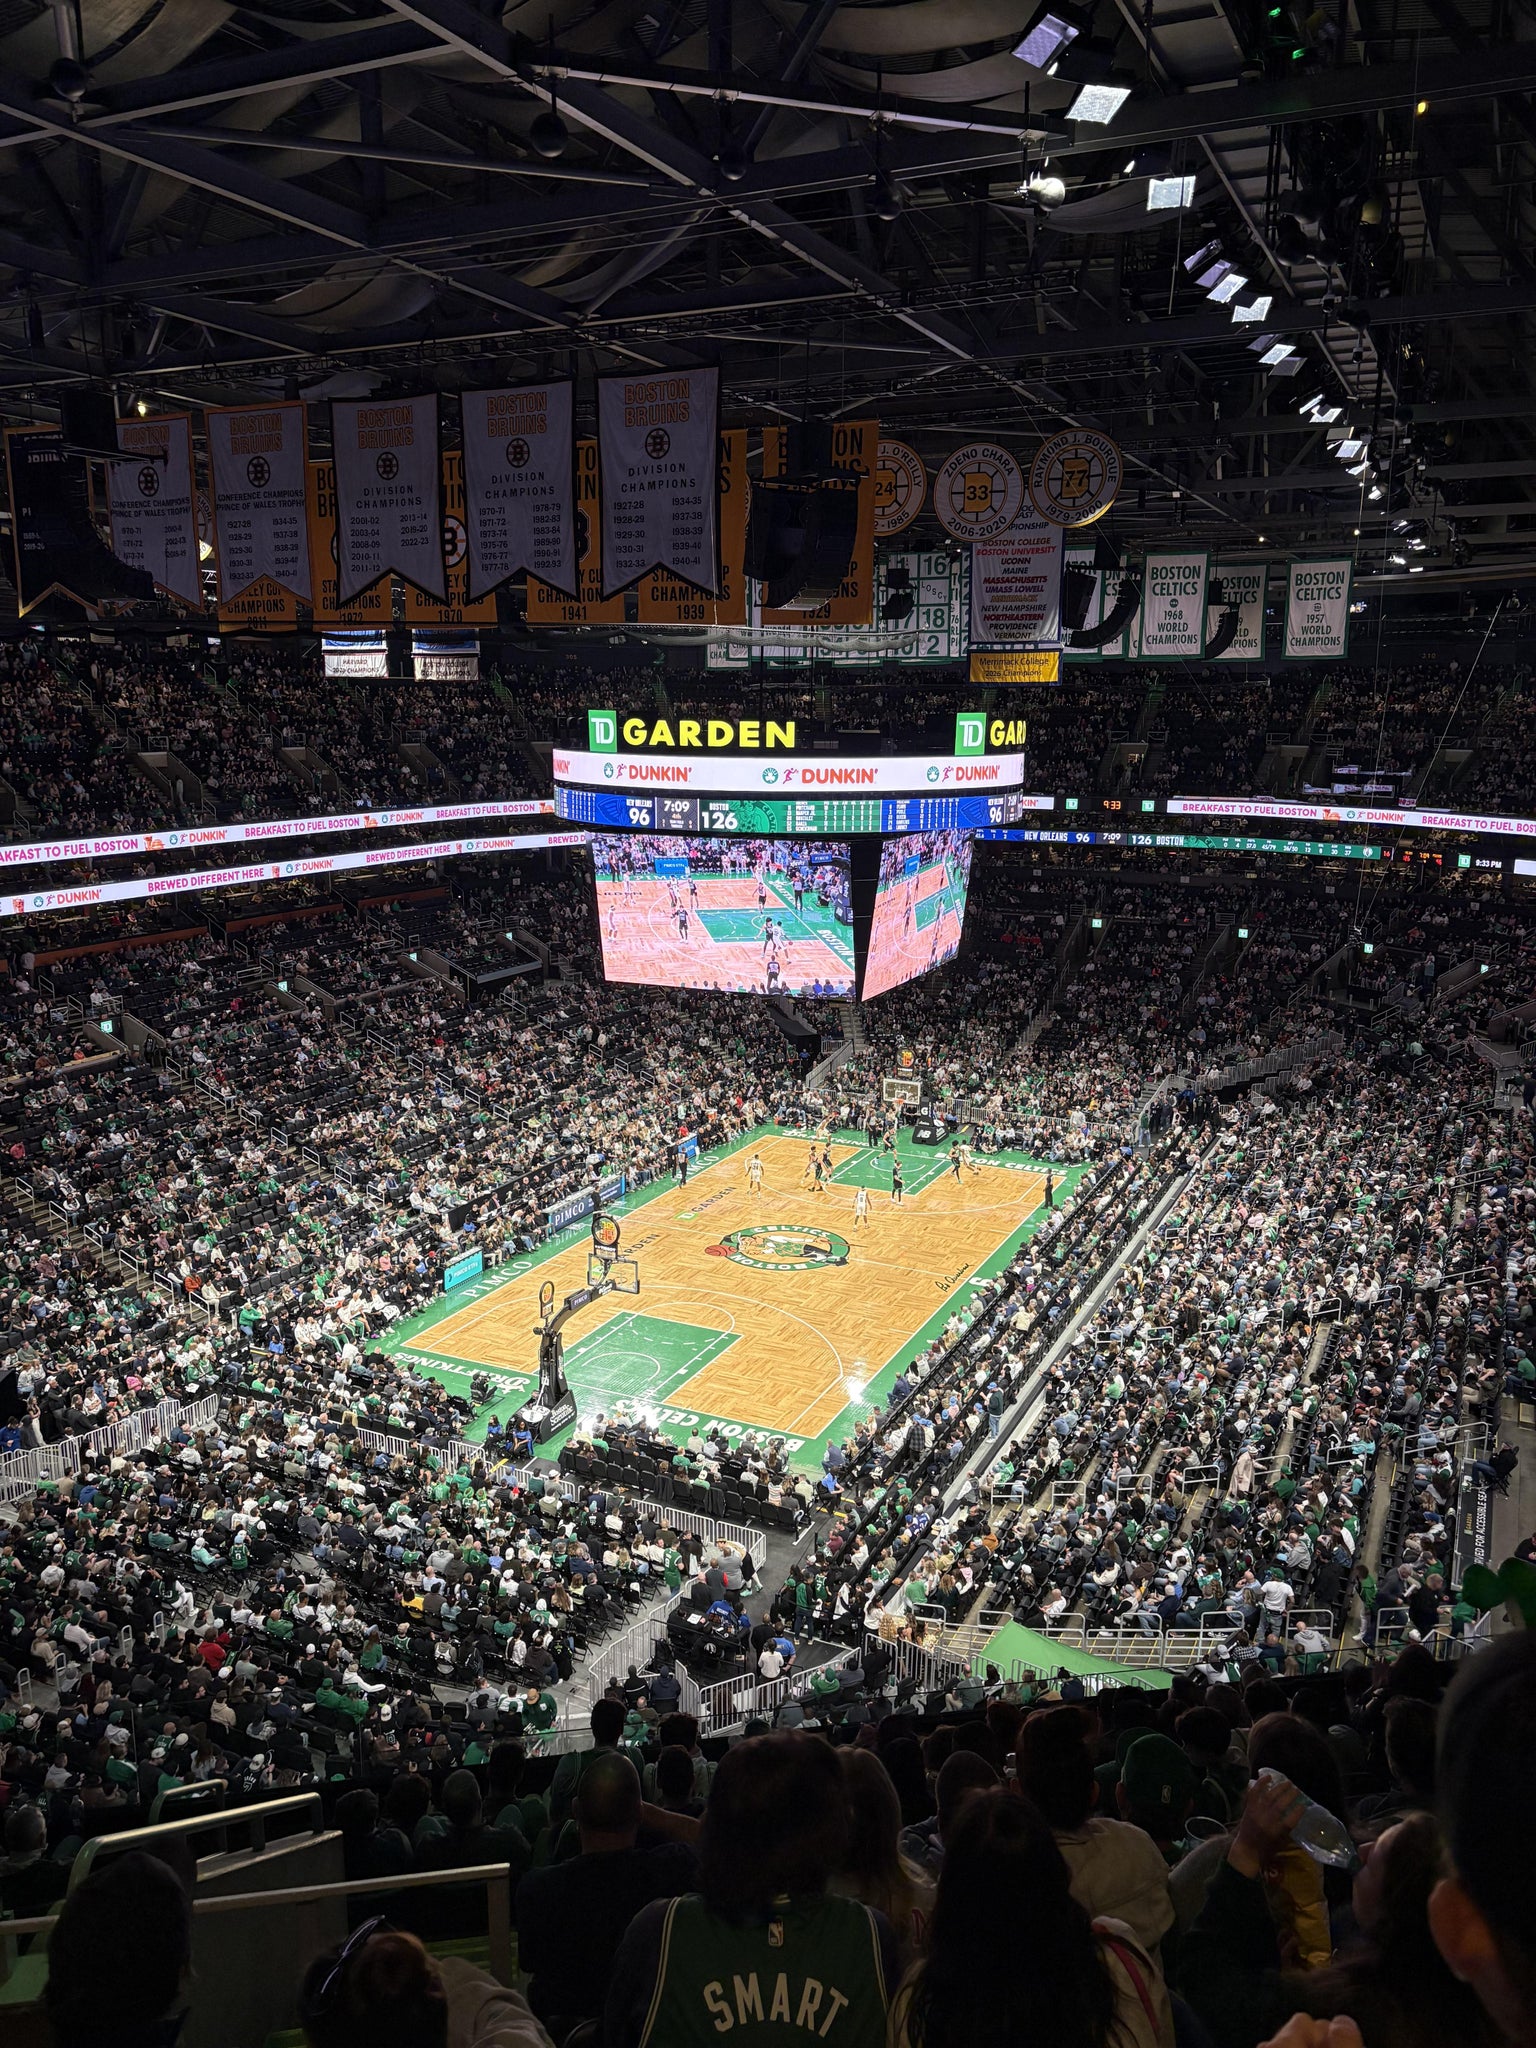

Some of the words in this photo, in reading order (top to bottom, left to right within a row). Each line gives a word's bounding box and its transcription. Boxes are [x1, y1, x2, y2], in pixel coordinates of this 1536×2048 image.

[624, 378, 690, 405] BOSTON
[487, 392, 547, 416] BOSTON
[357, 405, 413, 429] BOSTON
[625, 401, 690, 427] BRUINS
[230, 413, 283, 435] BOSTON
[487, 414, 547, 438] BRUINS
[231, 433, 282, 455] BRUINS
[358, 427, 414, 449] BRUINS
[881, 445, 889, 455] J.
[892, 446, 922, 489] O'REILLY
[943, 448, 978, 478] ZDENO
[981, 448, 1016, 477] CHARA
[1034, 436, 1069, 489] RAYMOND
[1072, 433, 1080, 443] J.
[1085, 434, 1117, 483] BOURQUE
[628, 463, 686, 477] DIVISION
[491, 472, 545, 484] DIVISION
[1065, 470, 1088, 488] 77
[363, 486, 413, 497] DIVISION
[485, 486, 555, 499] CHAMPIONS
[621, 479, 696, 493] CHAMPIONS
[875, 481, 894, 496] 24
[217, 491, 261, 501] CONFERENCE
[263, 489, 304, 499] CHAMPIONS
[966, 485, 990, 501] 33
[242, 501, 251, 510] OF
[253, 500, 277, 509] WALES
[356, 497, 422, 509] CHAMPIONS
[613, 500, 645, 510] 1927-28
[672, 496, 702, 506] 1934-35
[479, 507, 505, 516] 1970-71
[672, 512, 702, 521] 1937-38
[1046, 500, 1103, 522] 1979-2000
[351, 517, 380, 525] 2001-02
[480, 518, 506, 527] 1971-72
[613, 515, 645, 524] 1928-29
[351, 529, 380, 537] 2003-04
[672, 526, 703, 536] 1938-39
[947, 516, 1008, 537] 2006-2020
[480, 529, 507, 538] 1973-74
[614, 530, 645, 539] 1929-30
[400, 537, 429, 547] 2022-23
[982, 539, 1015, 548] BOSTON
[1017, 537, 1051, 547] COLLEGE
[615, 544, 644, 554] 1930-31
[976, 548, 1010, 556] BOSTON
[1011, 546, 1056, 556] UNIVERSITY
[351, 553, 380, 561] 2010-11
[616, 559, 646, 568] 1932-33
[1001, 557, 1031, 565] UCONN
[351, 564, 380, 572] 2011-12
[923, 555, 947, 576] 16
[1002, 566, 1029, 575] MAINE
[982, 575, 1048, 584] MASSACHUSETTS
[1151, 565, 1201, 581] BOSTON
[1295, 571, 1345, 587] BOSTON
[921, 581, 947, 603] LOSCY
[985, 586, 1014, 594] UMASS
[1014, 585, 1045, 593] LOWELL
[1152, 581, 1198, 597] CELTICS
[1296, 586, 1342, 601] CELTICS
[561, 605, 588, 620] 1941
[676, 605, 705, 620] 1939
[981, 604, 1000, 612] NEW
[1000, 603, 1047, 612] HAMPSHIRE
[438, 609, 463, 623] 1970
[922, 607, 945, 629] 18
[983, 613, 1044, 621] NORTHEASTERN
[1164, 610, 1184, 621] 1968
[1306, 614, 1325, 624] 1957
[989, 622, 1038, 630] PROVIDENCE
[1157, 622, 1189, 633] WORLD
[1301, 625, 1332, 635] WORLD
[994, 632, 1032, 640] VERMONT
[1146, 634, 1198, 645] CHAMPIONS
[1290, 636, 1341, 647] CHAMPIONS
[927, 635, 940, 655] 2
[979, 657, 1020, 667] Merrimack
[1020, 657, 1049, 669] College
[1003, 669, 1043, 679] Champions
[591, 717, 615, 745] TD
[622, 717, 796, 748] GARDEN
[959, 720, 984, 748] TD
[629, 764, 692, 782] DUNKIN'
[801, 767, 879, 785] DUNKIN'
[955, 764, 1001, 782] DUNKIN'
[436, 807, 471, 819] BREAKFAST
[471, 807, 481, 815] TO
[482, 805, 501, 814] FUEL
[503, 804, 535, 813] BOSTON
[663, 801, 690, 812] 7:09
[709, 802, 729, 811] BOSTON
[1103, 800, 1121, 810] 9:33
[629, 807, 650, 826] 96
[989, 807, 1002, 823] 96
[1183, 803, 1235, 813] BREAKFAST
[1238, 804, 1252, 814] TO
[1253, 805, 1277, 815] FUEL
[1278, 807, 1317, 818] BOSTON
[1366, 811, 1406, 822] DUNKIN'
[245, 823, 292, 838] BREAKFAST
[293, 822, 305, 833] TO
[307, 820, 327, 832] FUEL
[328, 817, 360, 830] BOSTON
[395, 811, 424, 824] DUNKIN'
[702, 811, 738, 830] 126
[1422, 815, 1471, 829] BREAKFAST
[1474, 819, 1488, 830] TO
[1490, 821, 1514, 832] FUEL
[1516, 823, 1536, 835] BOST
[548, 834, 577, 845] BREWED
[1024, 830, 1039, 841] NEW
[1039, 830, 1068, 842] ORLEANS
[1075, 833, 1090, 843] 96
[1103, 832, 1121, 841] 7:09
[1131, 835, 1152, 845] 126
[1156, 835, 1184, 846] BOSTON
[0, 847, 42, 863] AKFAST
[44, 845, 61, 858] TO
[64, 843, 92, 857] FUEL
[94, 838, 138, 854] BOSTON
[189, 830, 228, 843] DUNKIN'
[482, 839, 516, 850] DUNKIN'
[366, 852, 396, 864] BREWED
[397, 846, 434, 860] DIFFERENT
[434, 844, 451, 854] HERE
[1383, 850, 1391, 858] 16
[302, 859, 334, 872] DUNKIN'
[1475, 860, 1490, 868] 9:33
[1491, 861, 1502, 869] PM
[147, 879, 189, 893] BREWED
[190, 871, 240, 888] DIFFERENT
[242, 867, 265, 880] HERE
[57, 889, 102, 905] DUNKIN'
[920, 1107, 929, 1115] G
[1006, 1159, 1069, 1176] CELTICS
[691, 1185, 737, 1214] GARDEN
[554, 1201, 585, 1226] PIMCO
[753, 1225, 830, 1238] CELTICS
[730, 1255, 808, 1270] BOSTON
[461, 1261, 533, 1298] PIMCO
[574, 1294, 588, 1306] PIMCO
[703, 1419, 806, 1452] BOSTON
[1475, 1502, 1487, 1533] ACCESSIBLE
[1475, 1534, 1486, 1548] FOR
[703, 1972, 849, 2038] SMART
